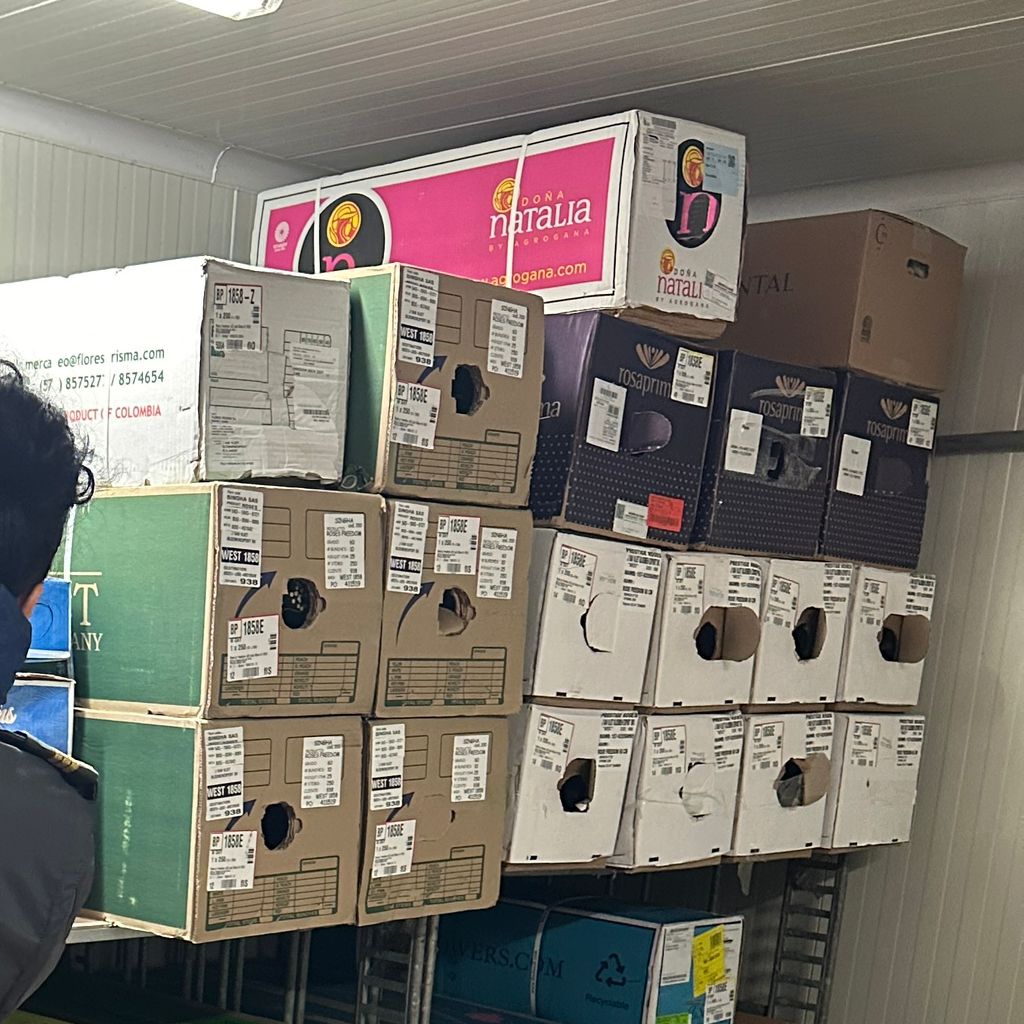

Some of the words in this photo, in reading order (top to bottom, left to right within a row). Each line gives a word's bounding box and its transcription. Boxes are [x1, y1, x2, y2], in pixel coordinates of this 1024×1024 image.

[521, 190, 564, 207] DOÑA
[515, 228, 590, 247] AGROGANA
[401, 326, 418, 340] WEST
[415, 356, 431, 365] 938
[65, 374, 105, 390] 857527
[118, 370, 164, 386] 8574654
[618, 366, 671, 398] rosaprim
[409, 385, 428, 403] 1858E
[115, 405, 162, 418] COLOMBIA
[759, 400, 803, 423] rosaprim
[867, 420, 908, 444] rosaprim
[449, 519, 468, 533] 1858E
[222, 550, 241, 561] WEST
[244, 551, 259, 563] 1858
[390, 557, 408, 570] WEST
[240, 578, 258, 586] 938
[73, 582, 99, 626] T
[230, 623, 239, 635] BP
[243, 619, 264, 635] 1858E
[207, 786, 226, 798] WEST
[227, 783, 241, 795] 1858
[224, 809, 241, 817] 938
[387, 823, 404, 838] 1858E
[212, 835, 220, 848] BP
[224, 834, 244, 848] 1858E
